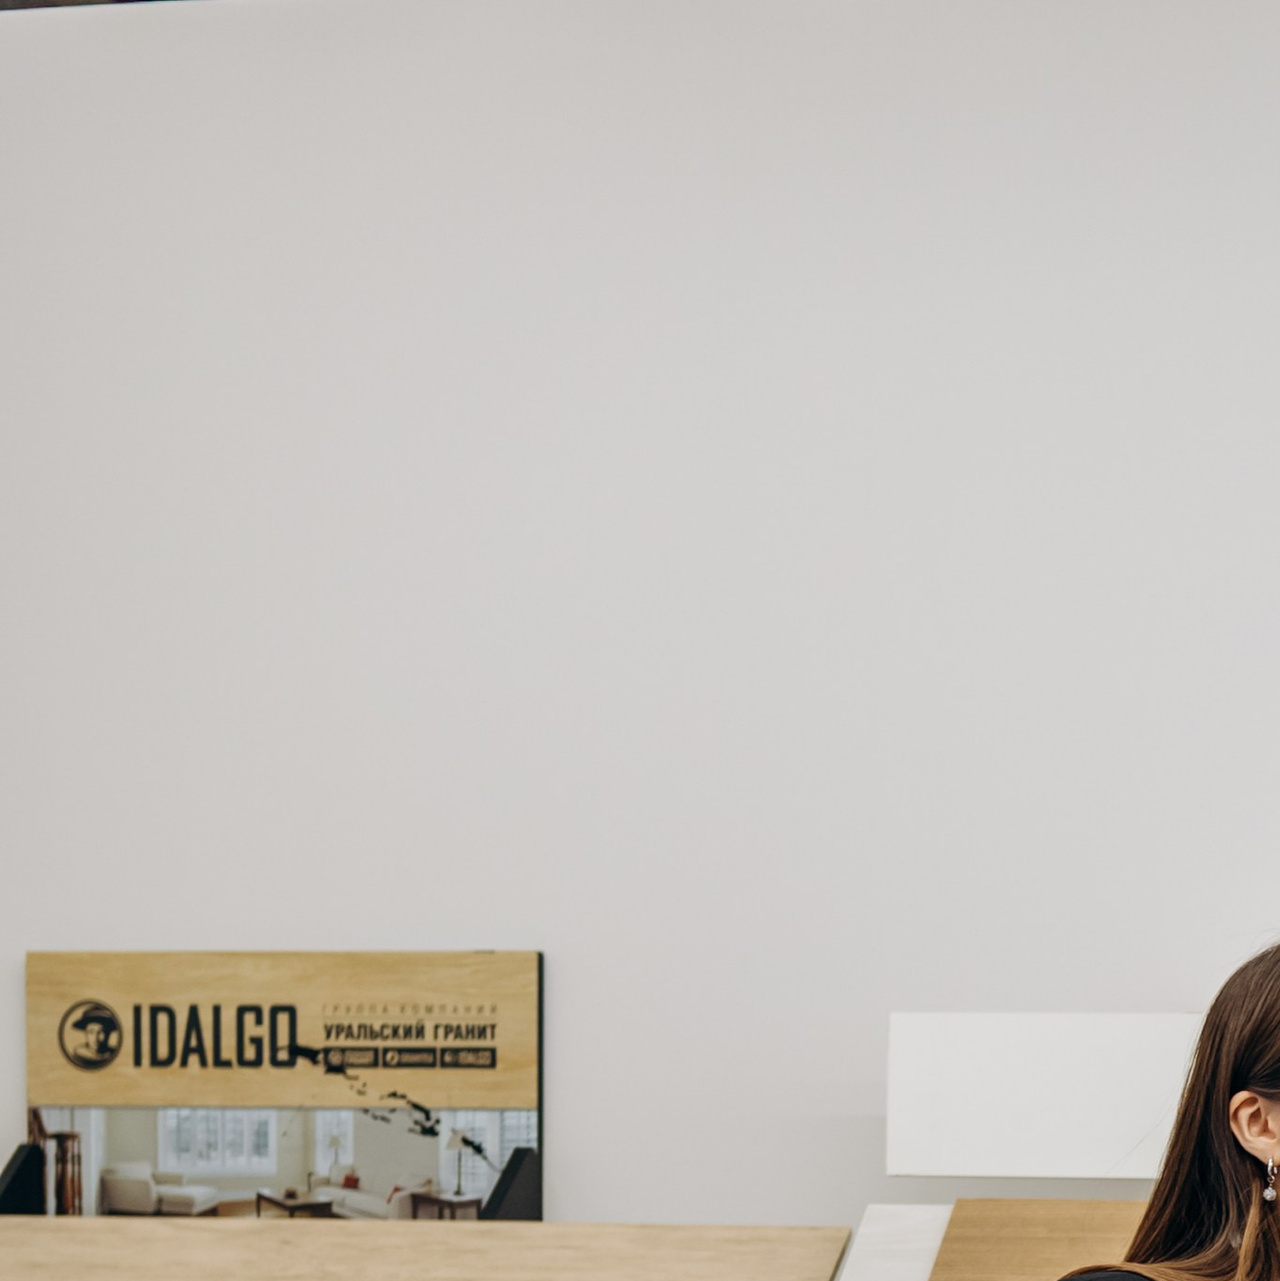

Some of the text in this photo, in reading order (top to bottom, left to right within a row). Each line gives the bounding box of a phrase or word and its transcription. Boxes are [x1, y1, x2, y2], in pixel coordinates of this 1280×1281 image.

[133, 1004, 298, 1068] IDALGO
[323, 1018, 498, 1041] УРАЛЬСКИЙ ГРАНИТ
